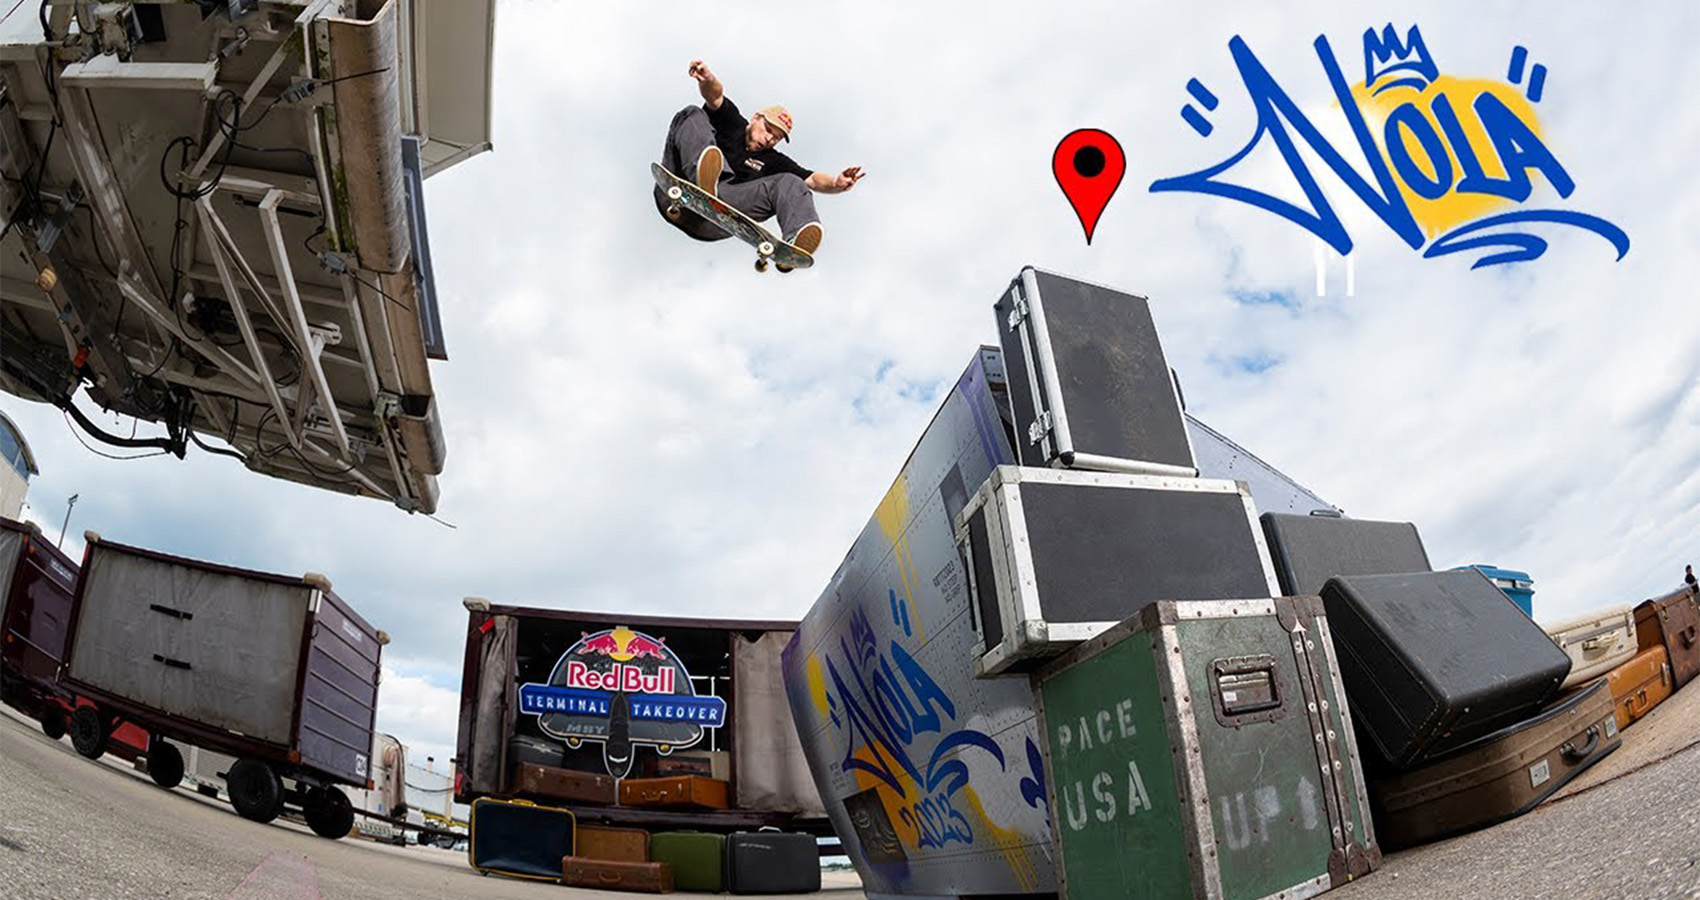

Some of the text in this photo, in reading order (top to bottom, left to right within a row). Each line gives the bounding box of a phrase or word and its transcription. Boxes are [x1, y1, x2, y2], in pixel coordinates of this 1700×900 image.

[526, 695, 718, 720] TERMINAL TAKEOVER
[567, 661, 675, 694] Red Bull
[825, 633, 956, 799] NOLA
[1058, 699, 1137, 759] PACE
[898, 791, 974, 850] 2023
[1063, 760, 1152, 832] USA
[1221, 784, 1282, 850] UP
